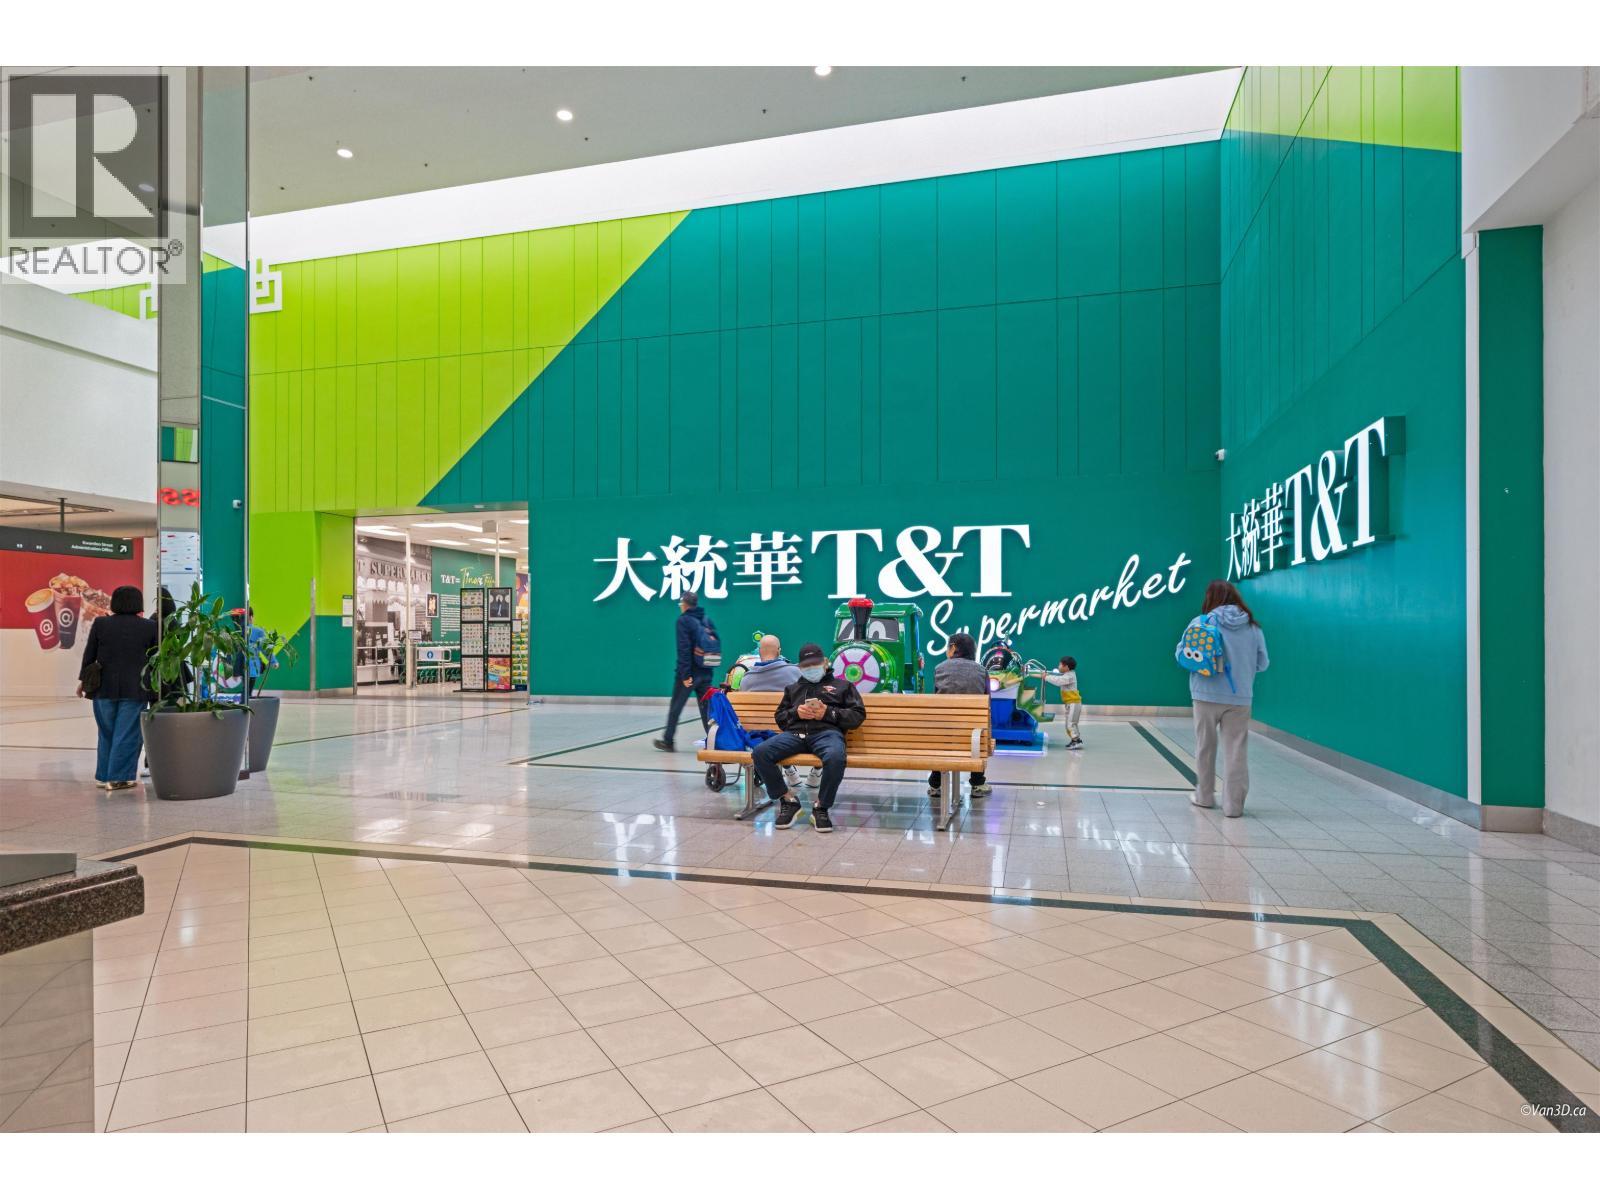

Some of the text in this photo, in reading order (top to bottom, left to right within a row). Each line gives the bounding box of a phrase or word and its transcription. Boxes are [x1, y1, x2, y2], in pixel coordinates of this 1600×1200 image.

[1225, 416, 1386, 582] 大統華 T&T
[592, 523, 1031, 602] 大統華 T&T
